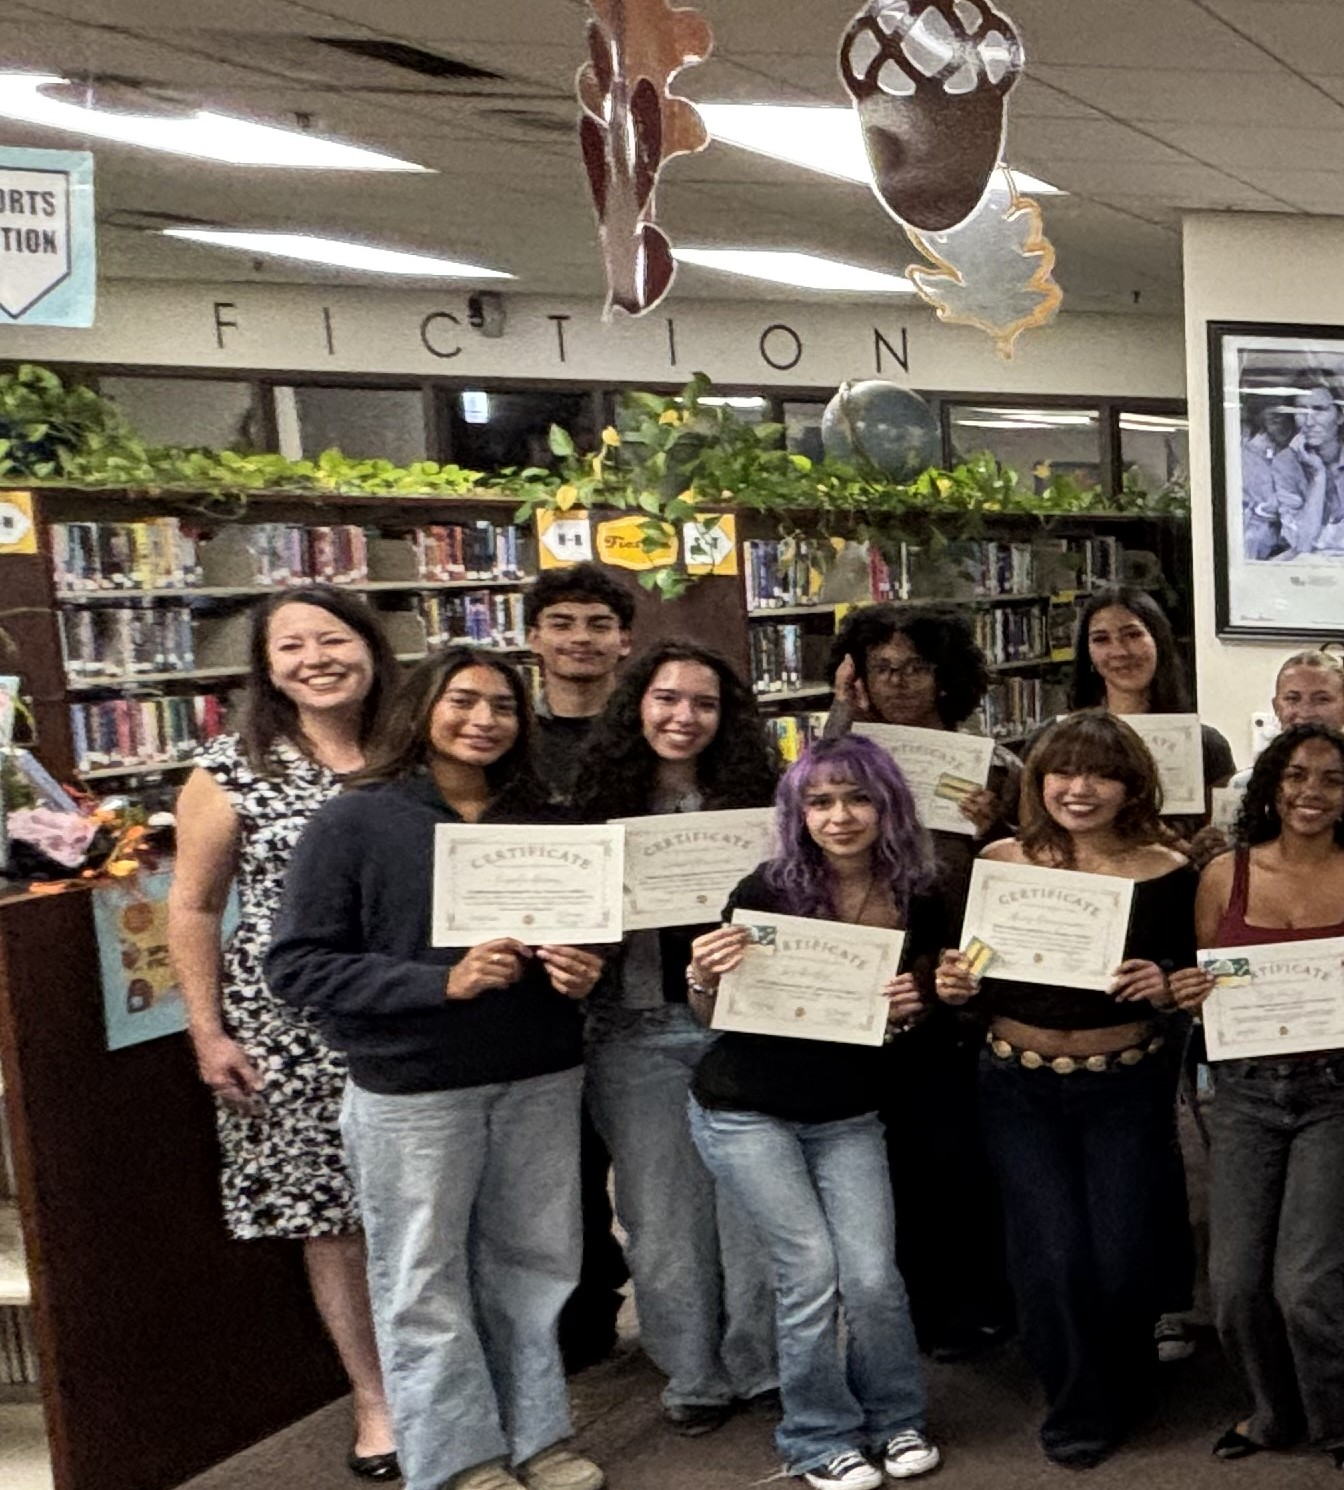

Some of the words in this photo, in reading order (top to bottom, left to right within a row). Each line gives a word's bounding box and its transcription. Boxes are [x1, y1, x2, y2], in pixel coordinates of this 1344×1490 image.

[213, 303, 908, 373] FICTION
[470, 845, 593, 870] CERTIFICATE
[998, 887, 1102, 917] CERTIFICATE
[783, 937, 868, 971] RTIFICATE
[1250, 963, 1331, 982] RTIFICATE
